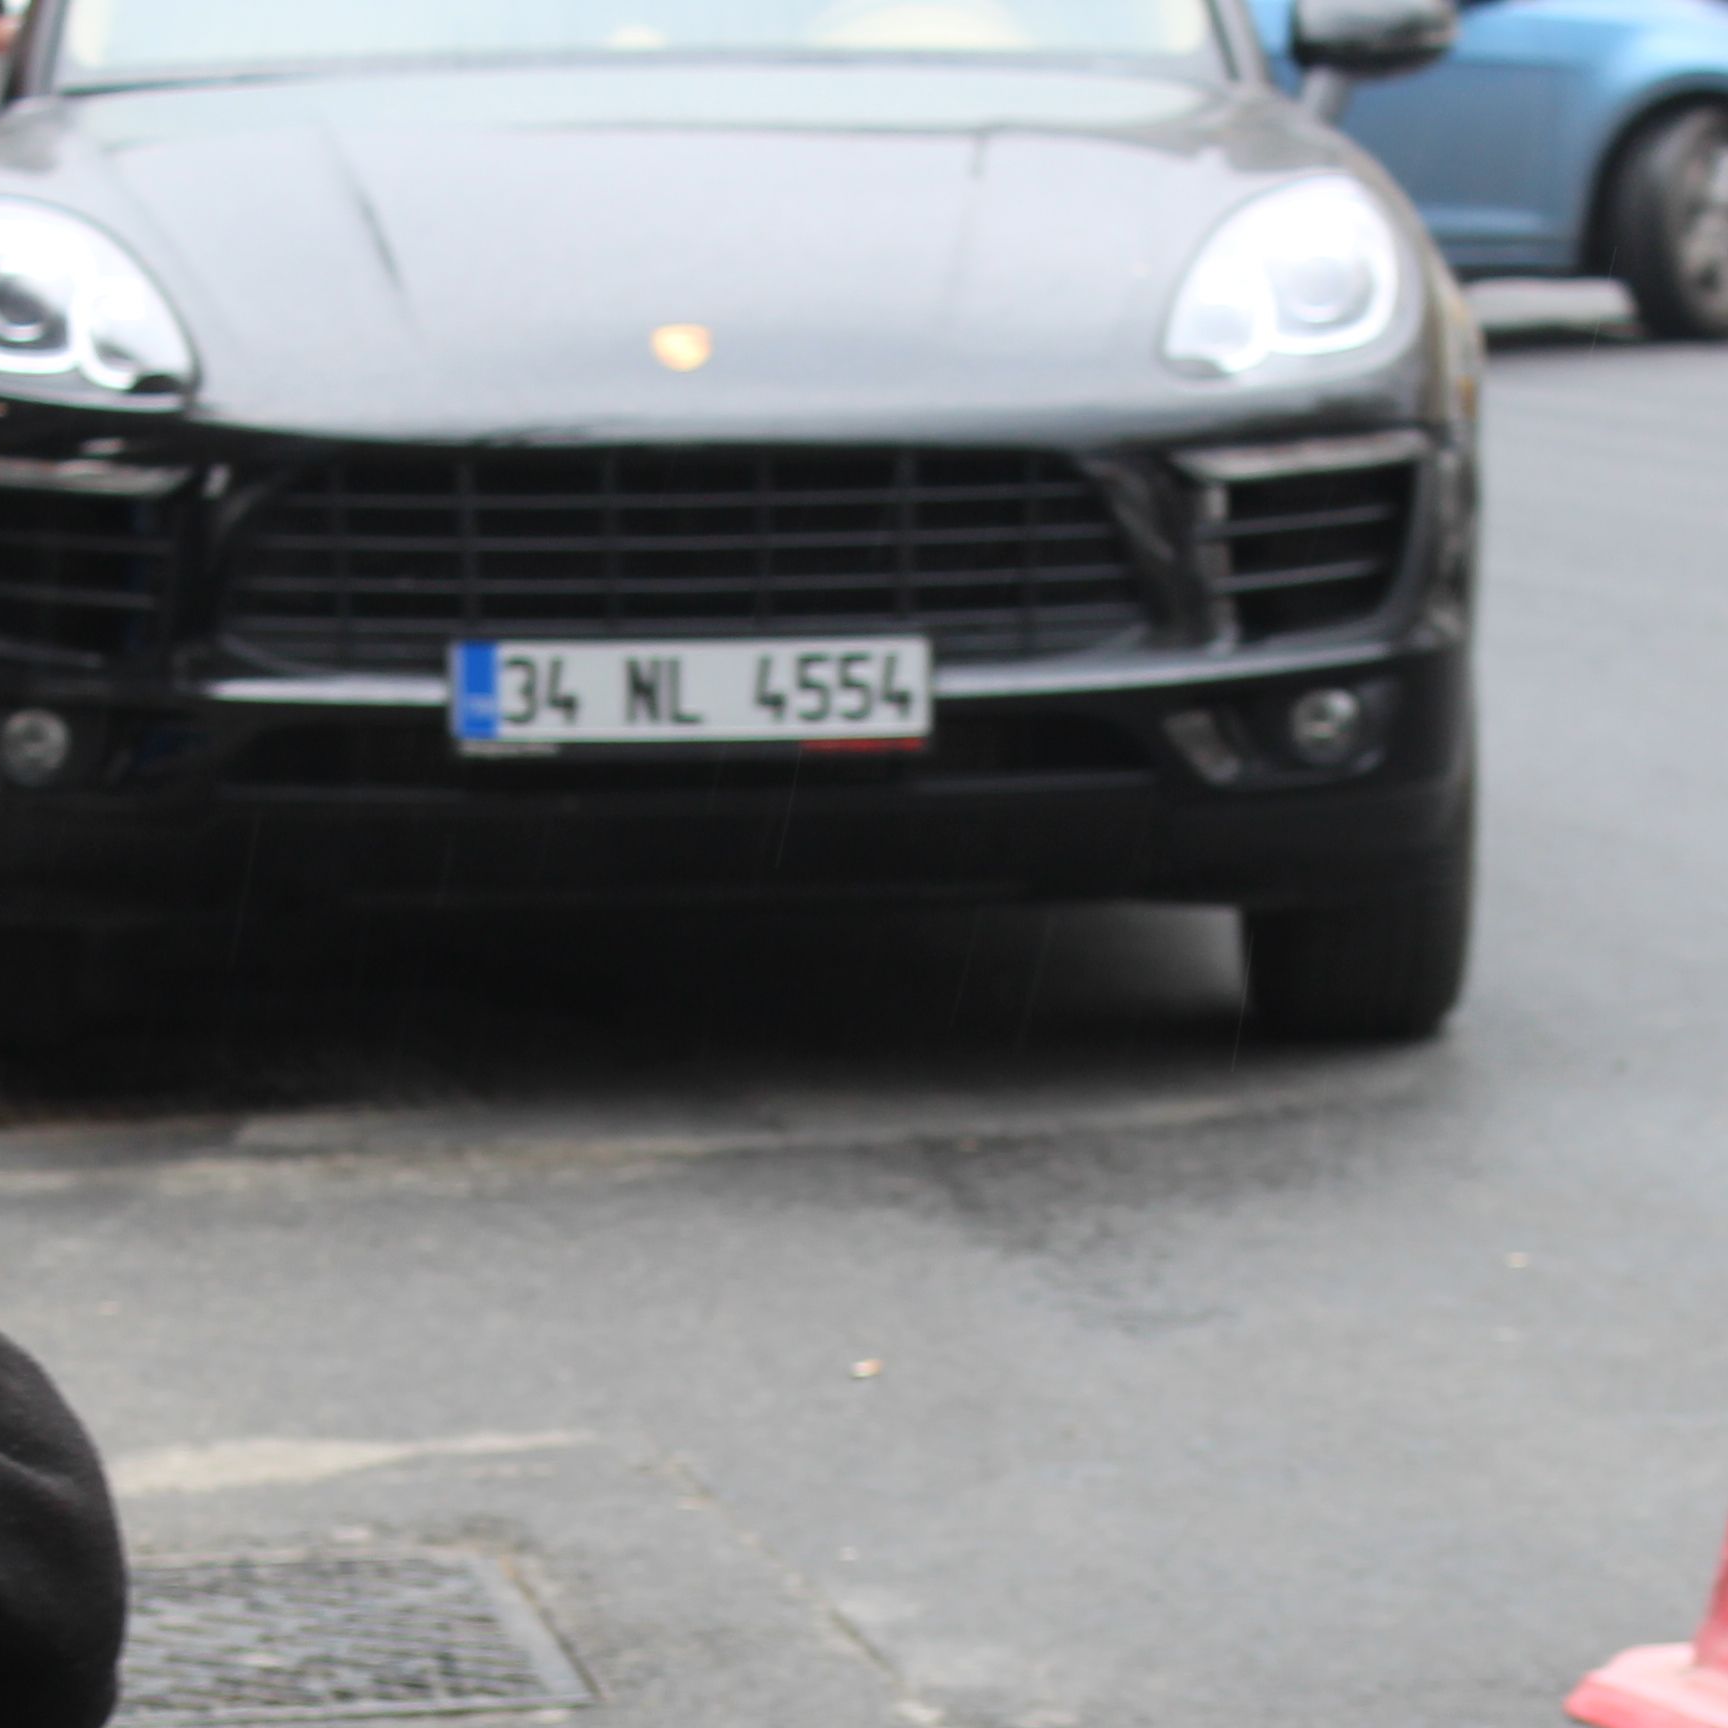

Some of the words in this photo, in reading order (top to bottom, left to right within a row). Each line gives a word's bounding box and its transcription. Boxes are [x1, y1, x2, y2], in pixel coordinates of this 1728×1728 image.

[502, 656, 579, 727] 34
[622, 656, 703, 725] NL
[752, 652, 913, 722] 4554
